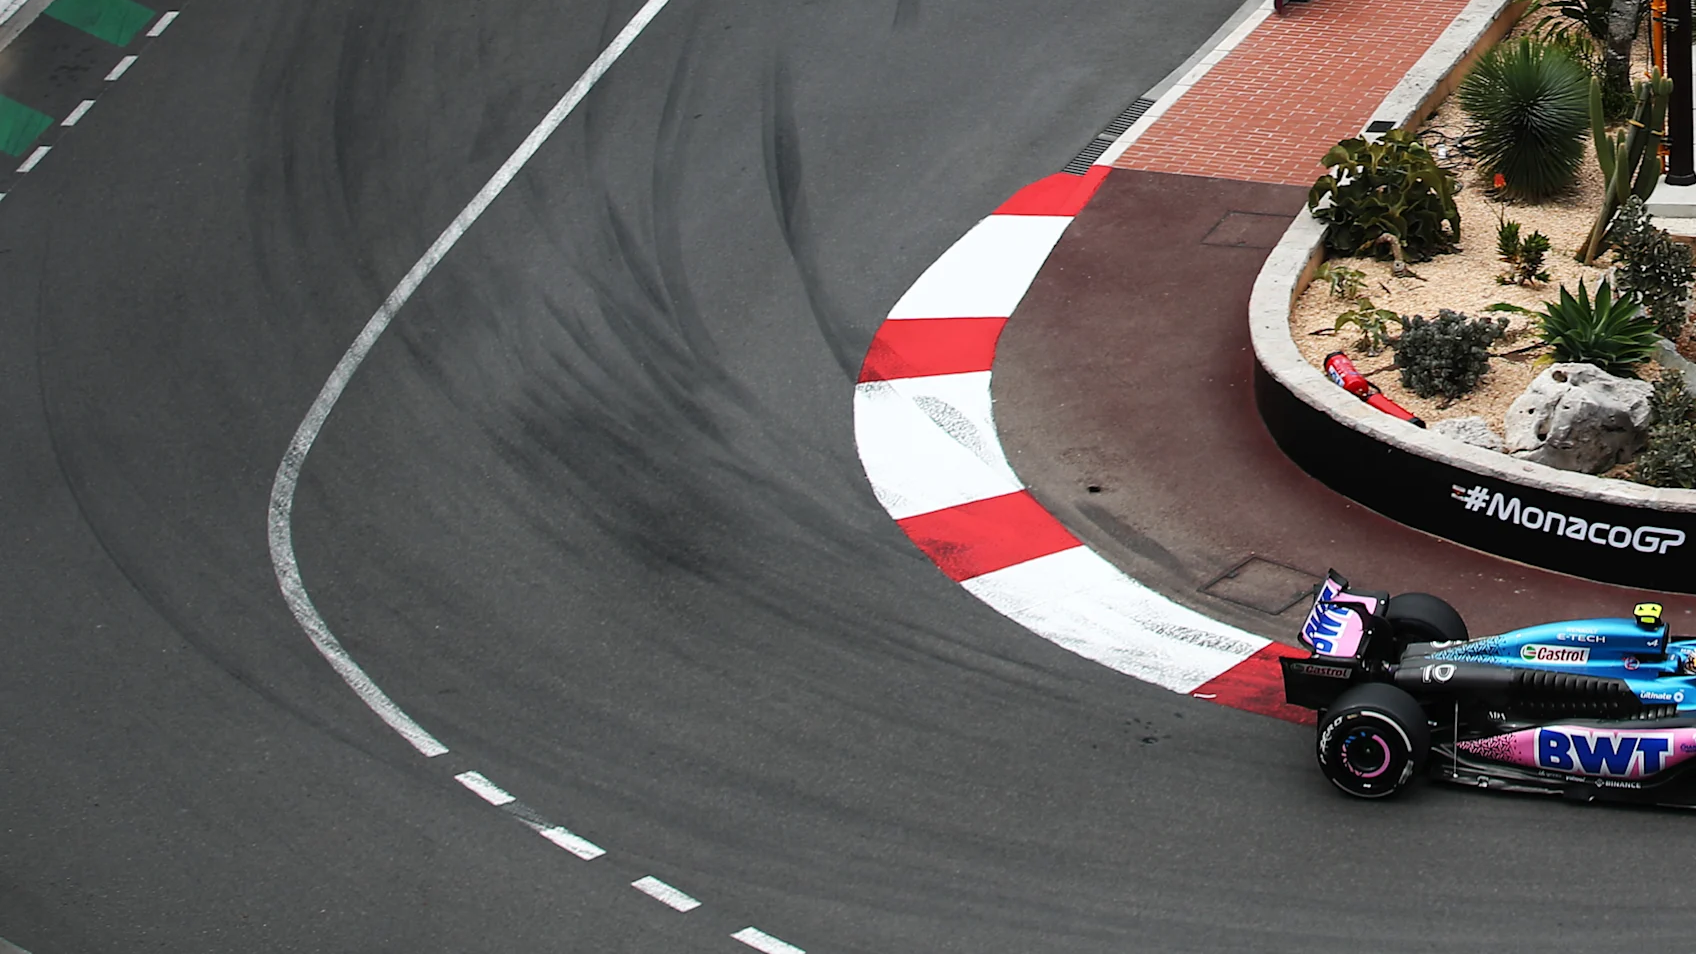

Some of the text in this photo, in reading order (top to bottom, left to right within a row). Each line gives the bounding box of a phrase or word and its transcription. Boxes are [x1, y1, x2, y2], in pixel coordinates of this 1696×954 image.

[1464, 485, 1687, 554] #MonacoGP
[1556, 633, 1607, 644] E-TECH
[1537, 647, 1586, 663] Castrol
[1305, 665, 1348, 677] Castrol
[1422, 663, 1457, 683] 10
[1538, 728, 1670, 776] BWT
[1605, 780, 1642, 790] BINANCE
